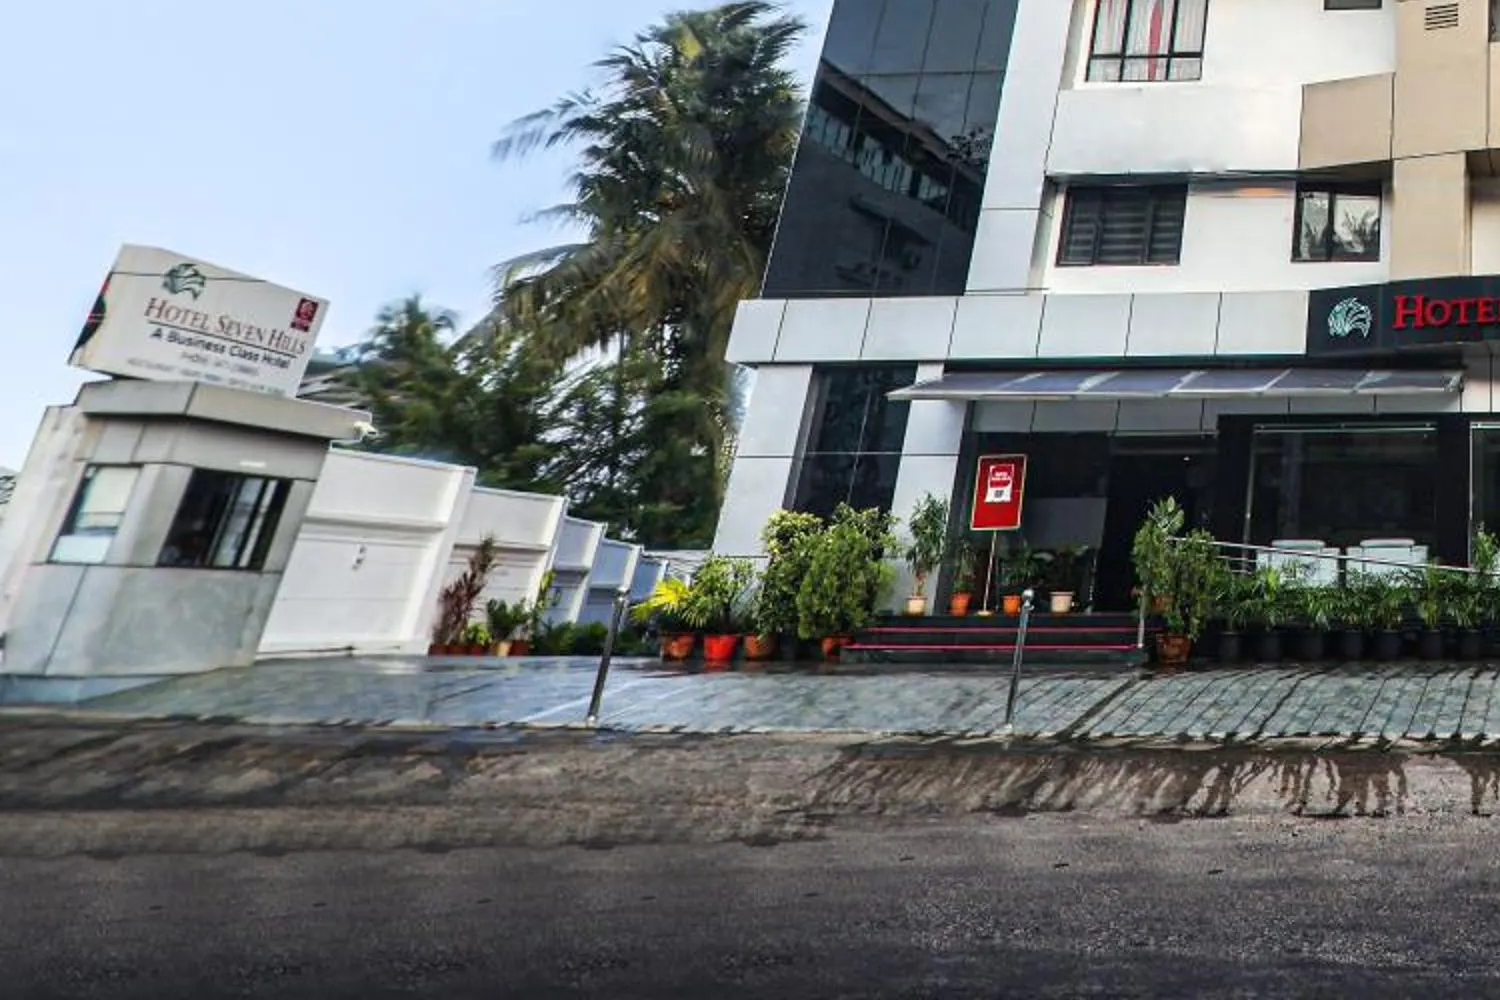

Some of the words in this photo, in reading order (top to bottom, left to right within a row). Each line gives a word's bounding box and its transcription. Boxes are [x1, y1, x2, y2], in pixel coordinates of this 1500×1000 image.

[144, 298, 211, 331] HOTEL
[214, 313, 265, 342] SEVEN
[267, 328, 306, 354] HILLS
[151, 327, 163, 338] A
[167, 330, 225, 354] Business
[228, 345, 260, 362] Class
